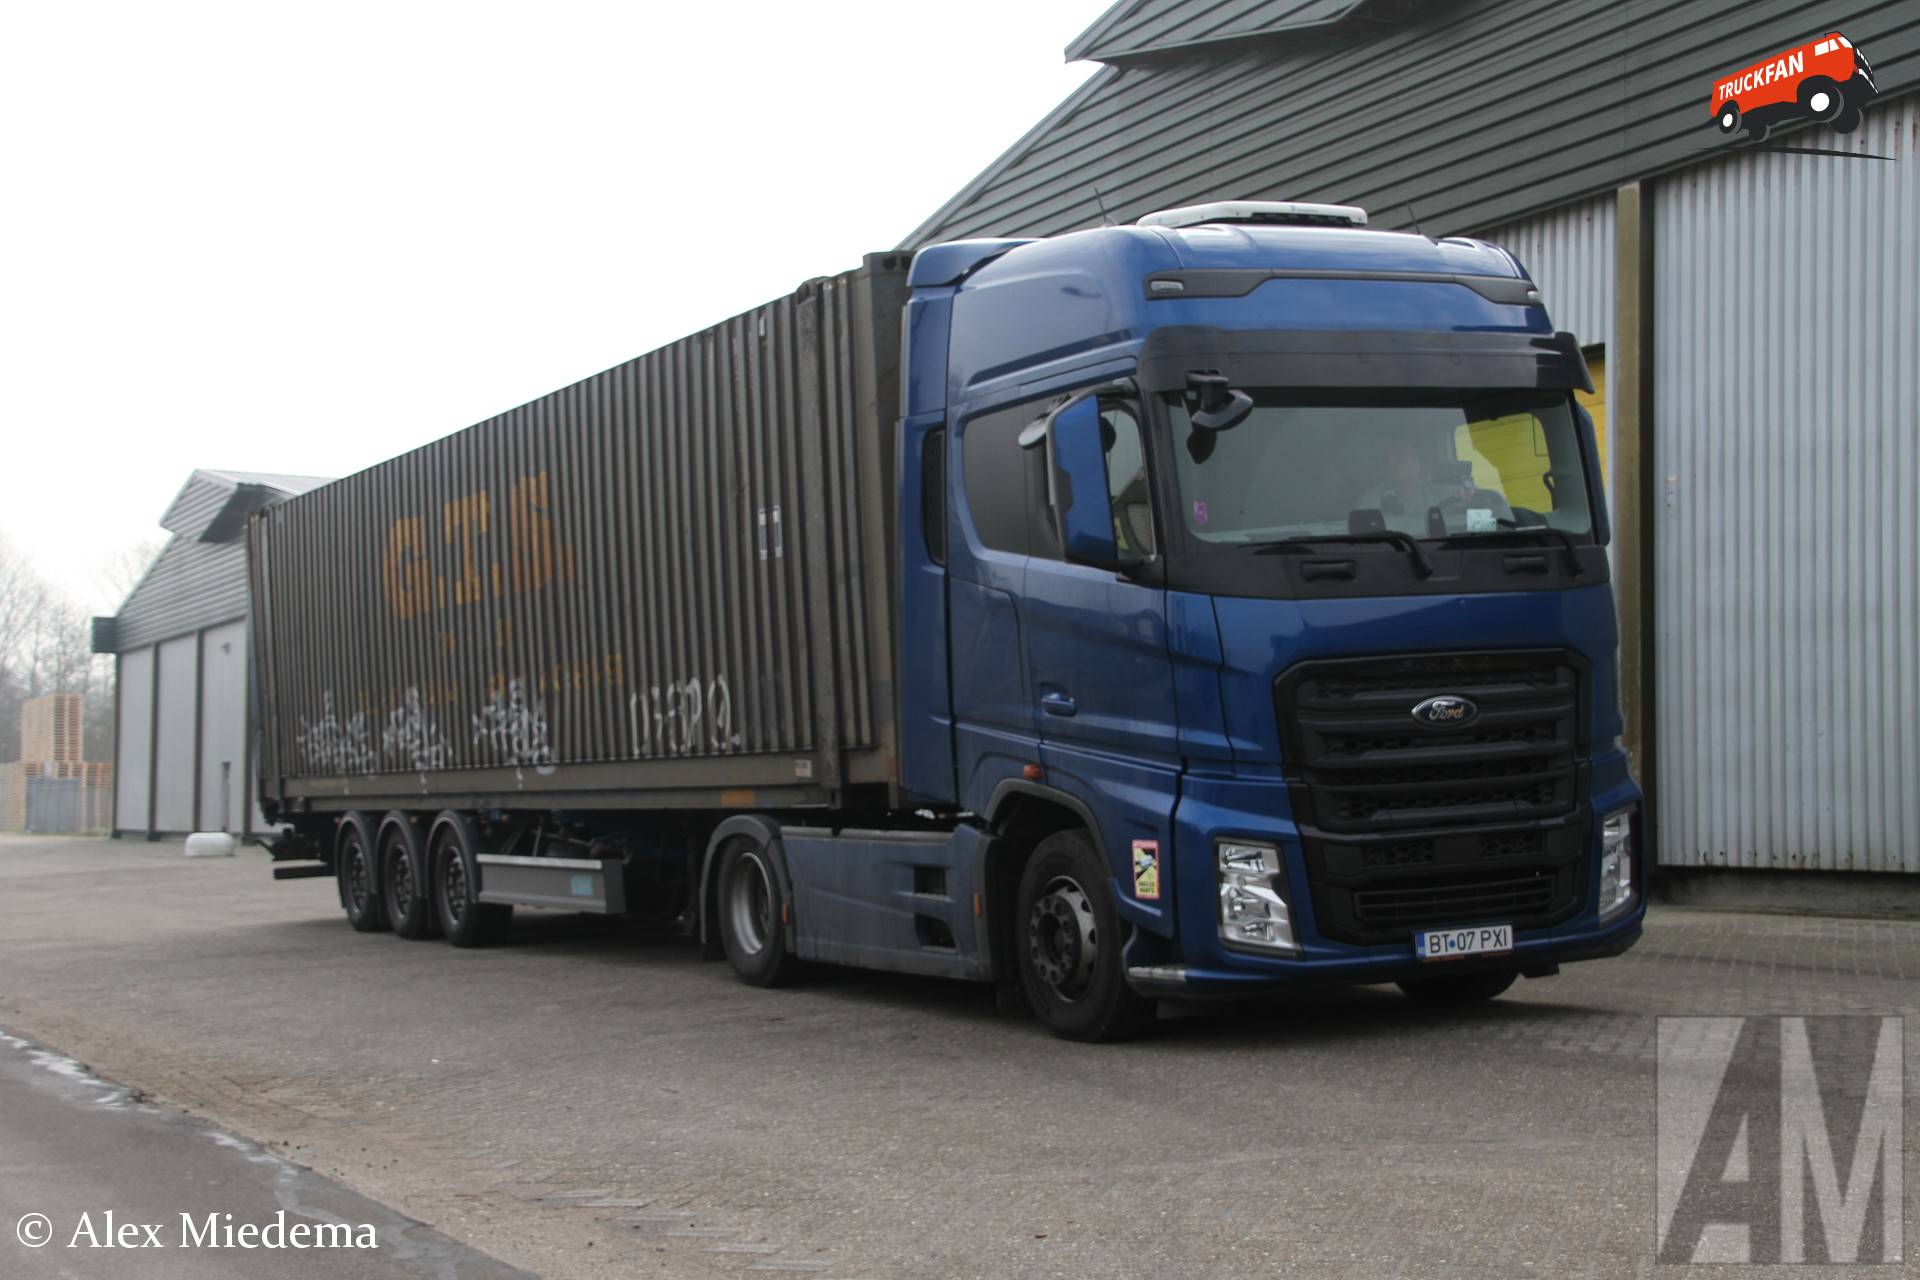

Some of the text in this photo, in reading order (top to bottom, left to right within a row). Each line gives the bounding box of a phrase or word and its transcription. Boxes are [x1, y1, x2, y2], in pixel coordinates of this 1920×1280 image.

[1429, 700, 1464, 720] Ford
[1429, 928, 1507, 954] BT 07 PXI
